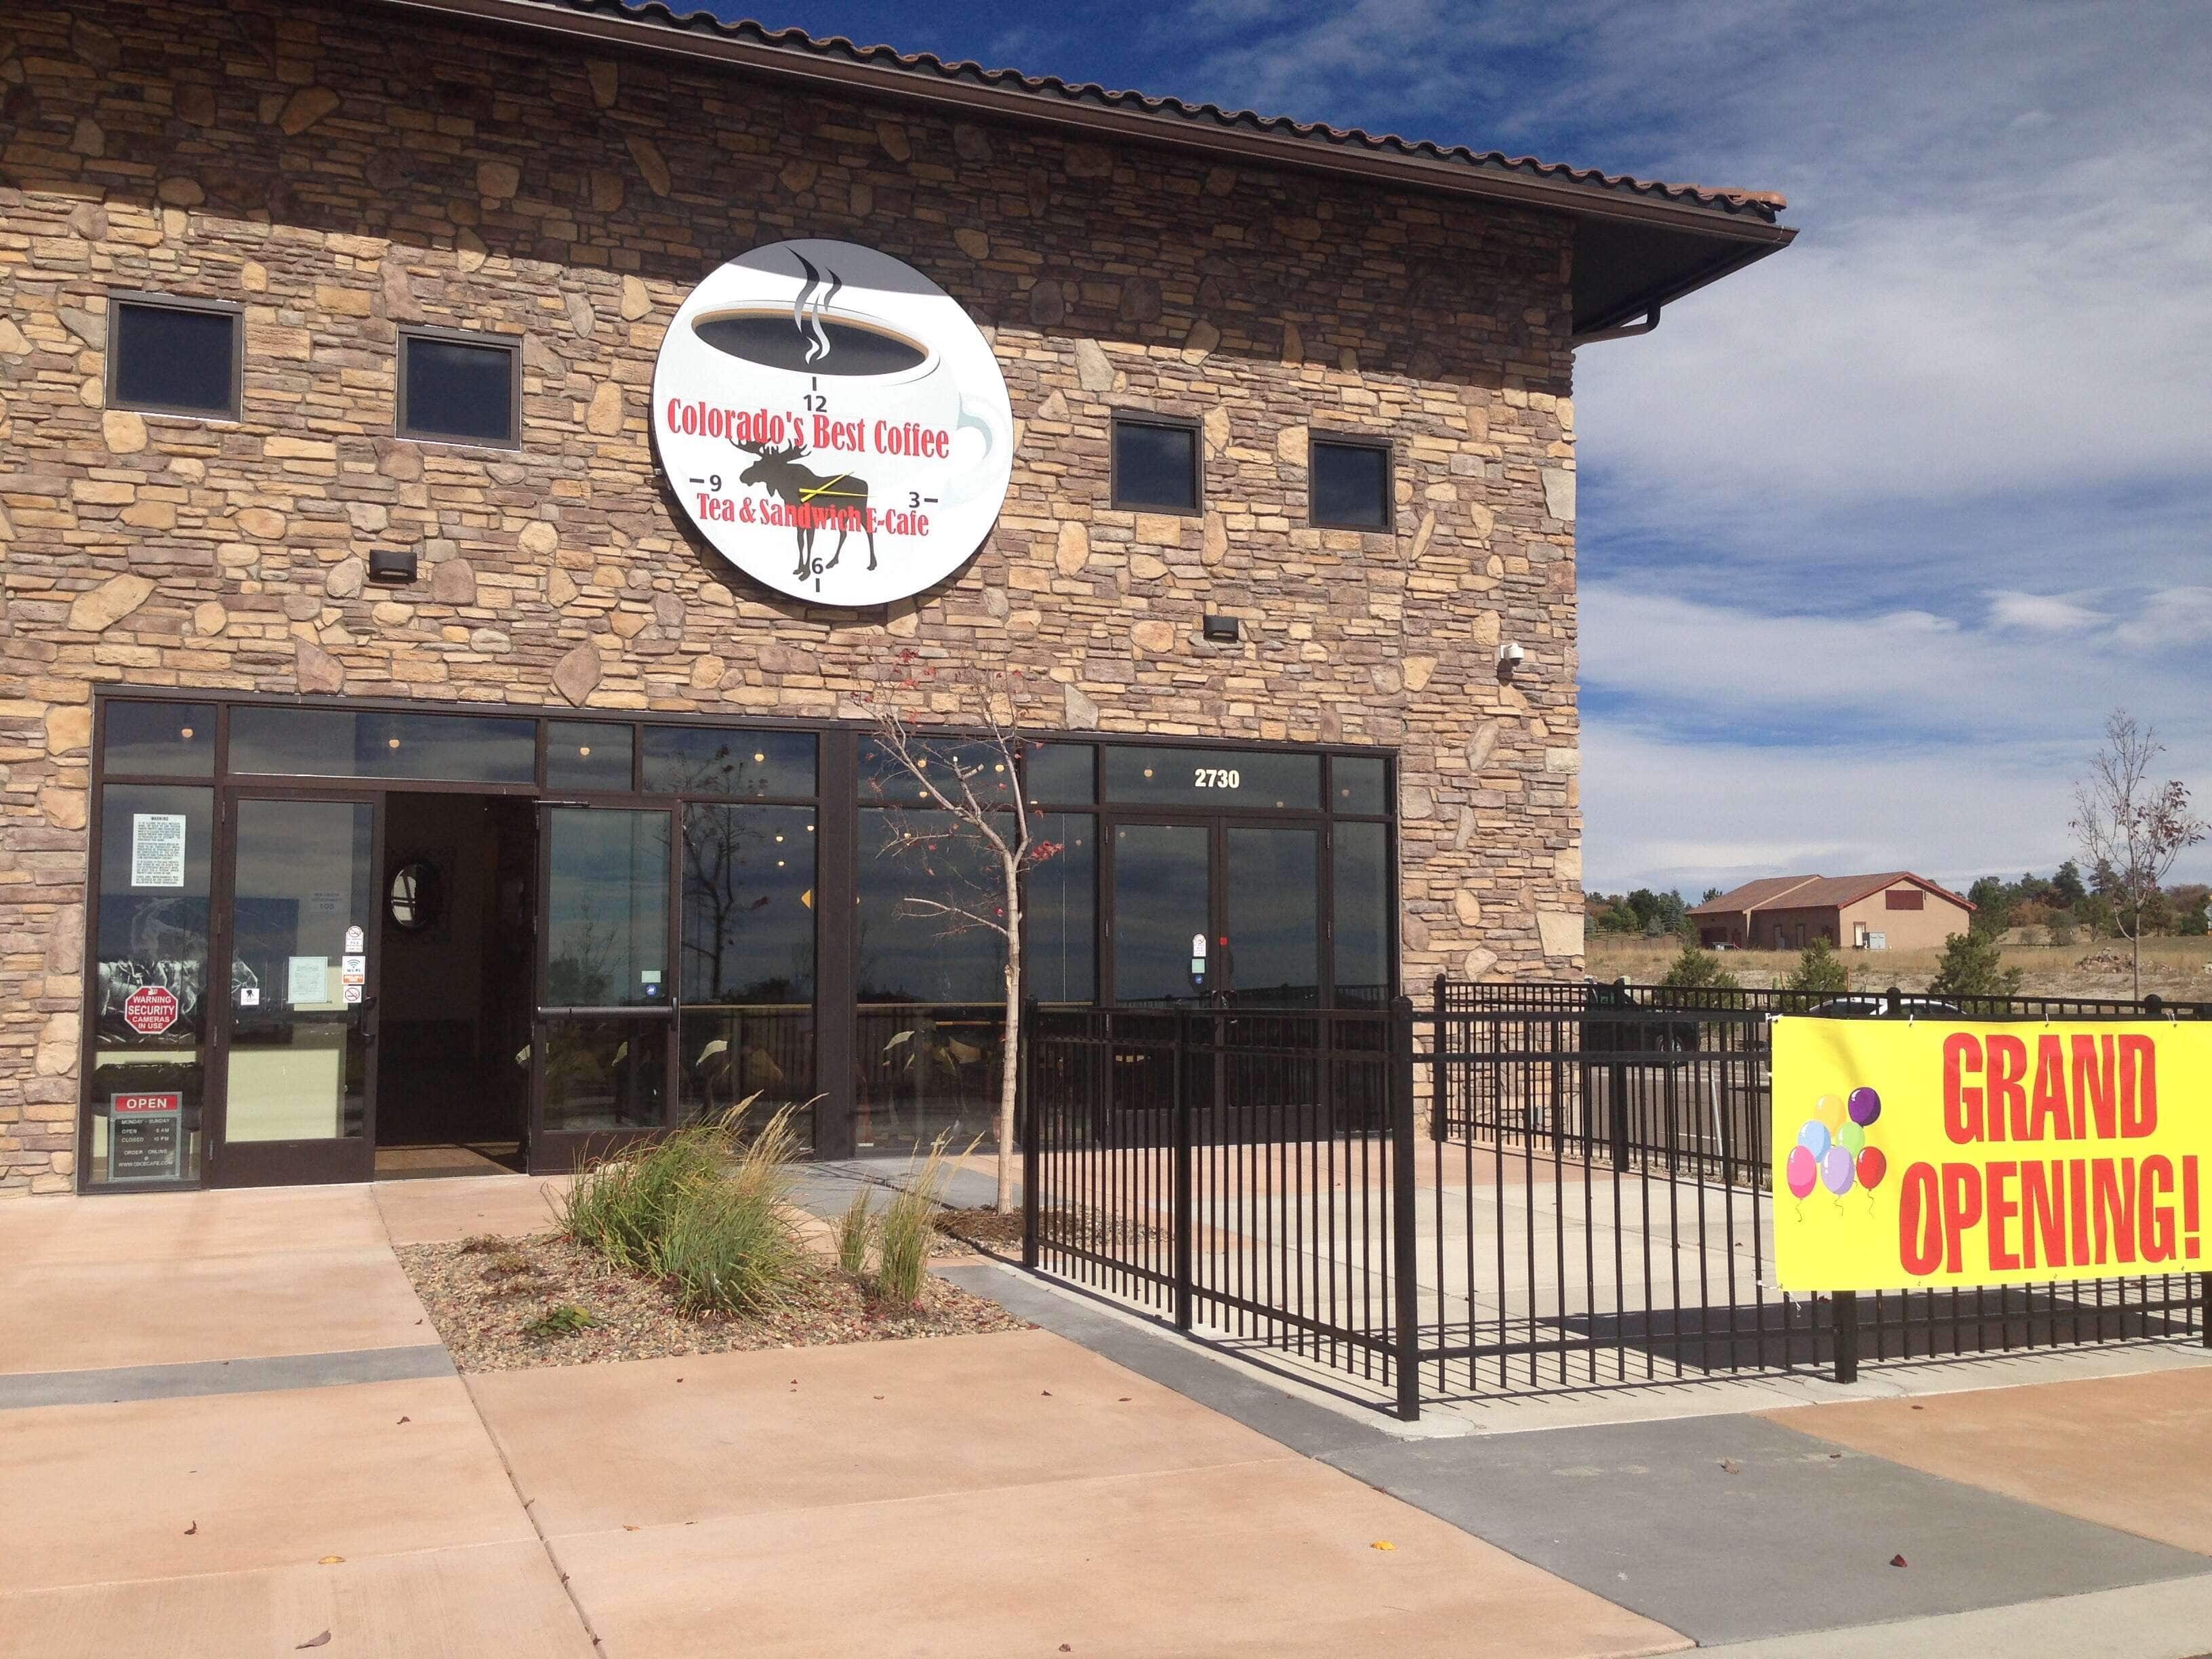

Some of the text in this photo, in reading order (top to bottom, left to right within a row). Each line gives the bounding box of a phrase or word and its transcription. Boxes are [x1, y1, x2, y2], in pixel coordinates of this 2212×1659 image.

[803, 394, 827, 413] 12
[668, 398, 949, 459] Colorado's Best Coffee
[710, 474, 722, 492] 9
[909, 491, 920, 508] 3
[697, 493, 929, 536] Tea & Sandwich E-Cafe
[812, 558, 823, 575] 6
[1194, 769, 1240, 788] 2730
[133, 996, 171, 1004] WARNING
[128, 1005, 175, 1015] SECURITY
[1942, 1032, 2158, 1145] GRAND
[127, 1099, 167, 1109] OPEN
[1899, 1154, 2200, 1276] OPENING!
